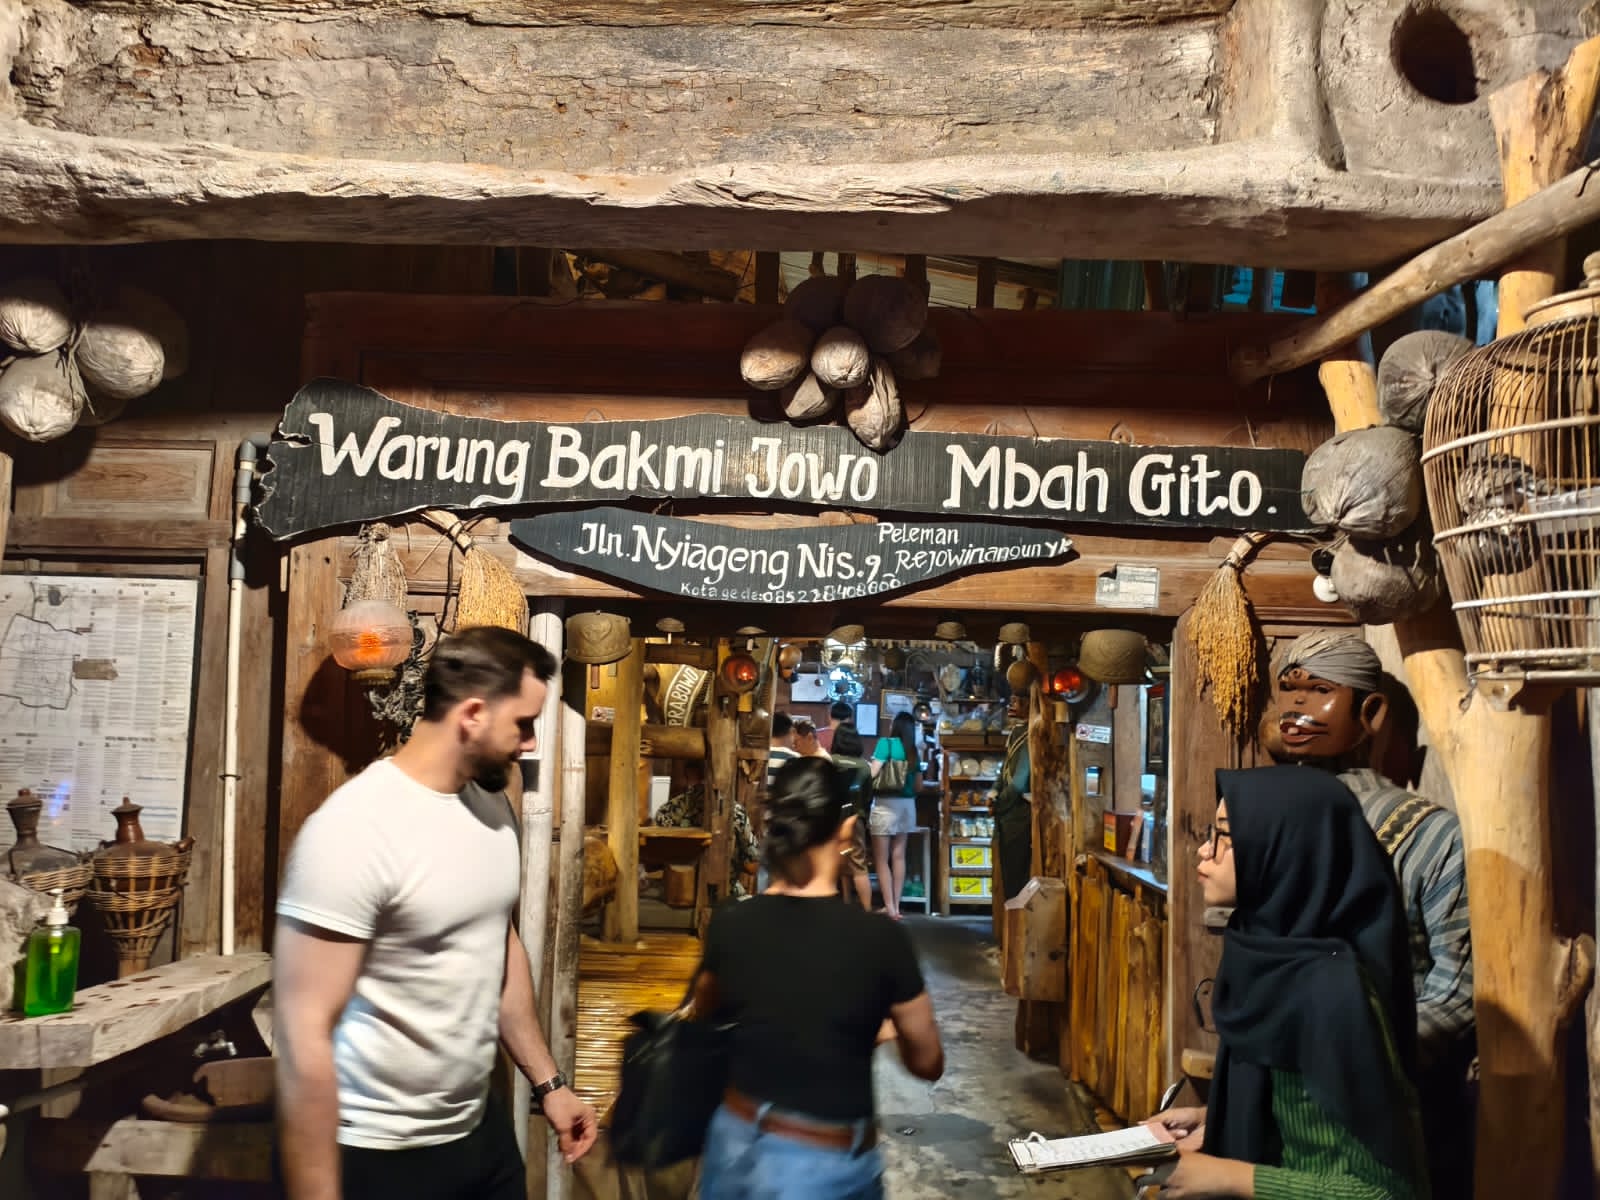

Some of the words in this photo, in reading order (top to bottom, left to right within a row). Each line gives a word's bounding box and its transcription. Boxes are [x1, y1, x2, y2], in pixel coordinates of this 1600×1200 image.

[308, 412, 531, 509] Warung
[540, 425, 725, 495] Bakmi
[744, 436, 879, 503] Jowo
[942, 444, 1109, 513] Mbah
[876, 522, 959, 545] Peleman
[667, 666, 700, 727] PRABOWO
